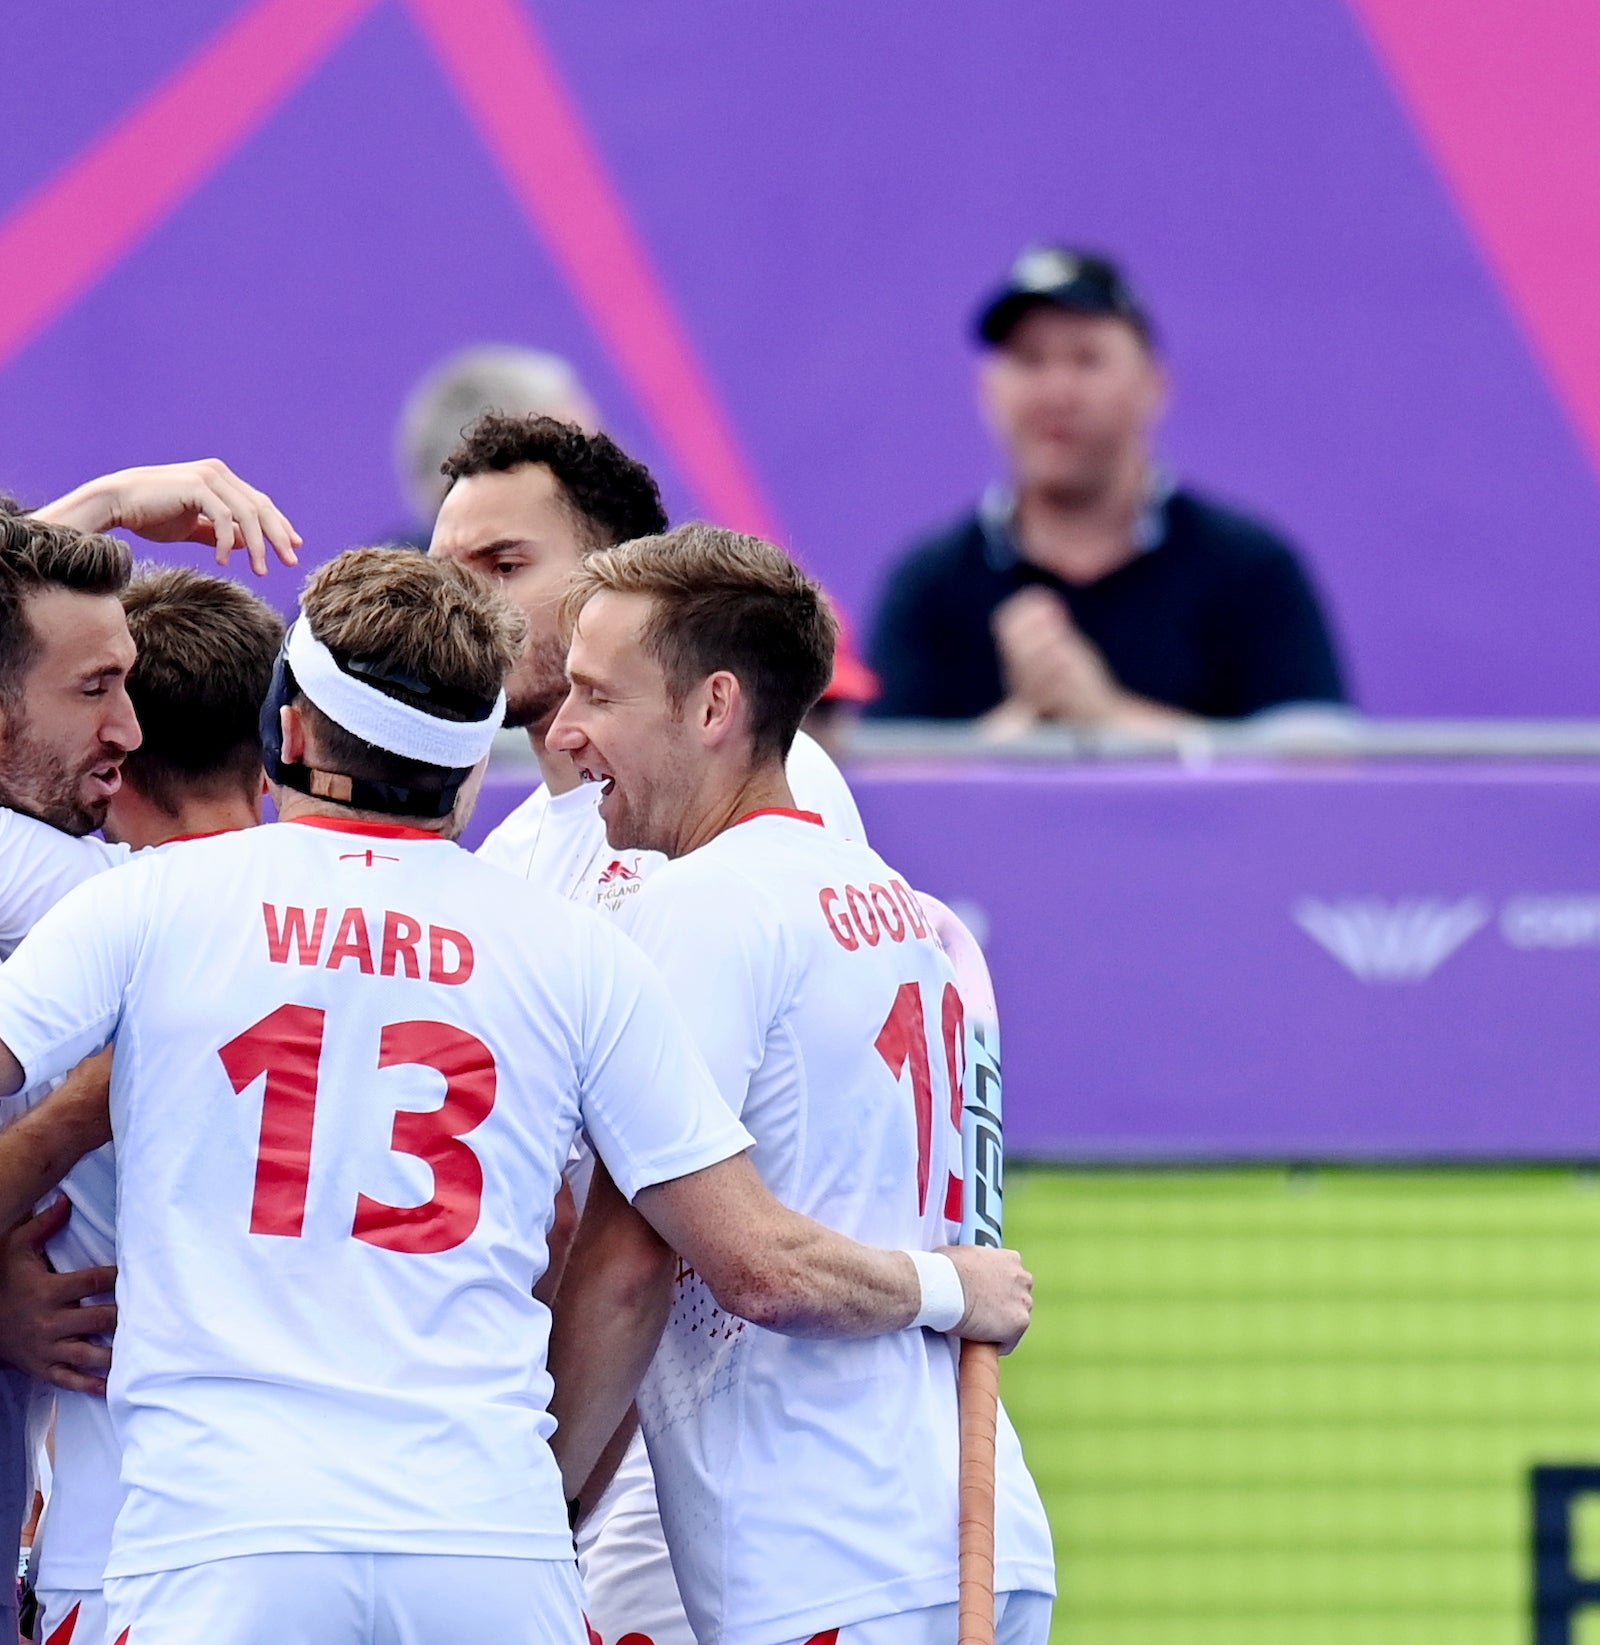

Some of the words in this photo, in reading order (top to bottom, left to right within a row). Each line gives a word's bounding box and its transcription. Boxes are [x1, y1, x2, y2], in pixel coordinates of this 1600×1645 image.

[262, 901, 475, 986] WARD
[818, 878, 943, 951] GOOD
[217, 1002, 498, 1255] 13
